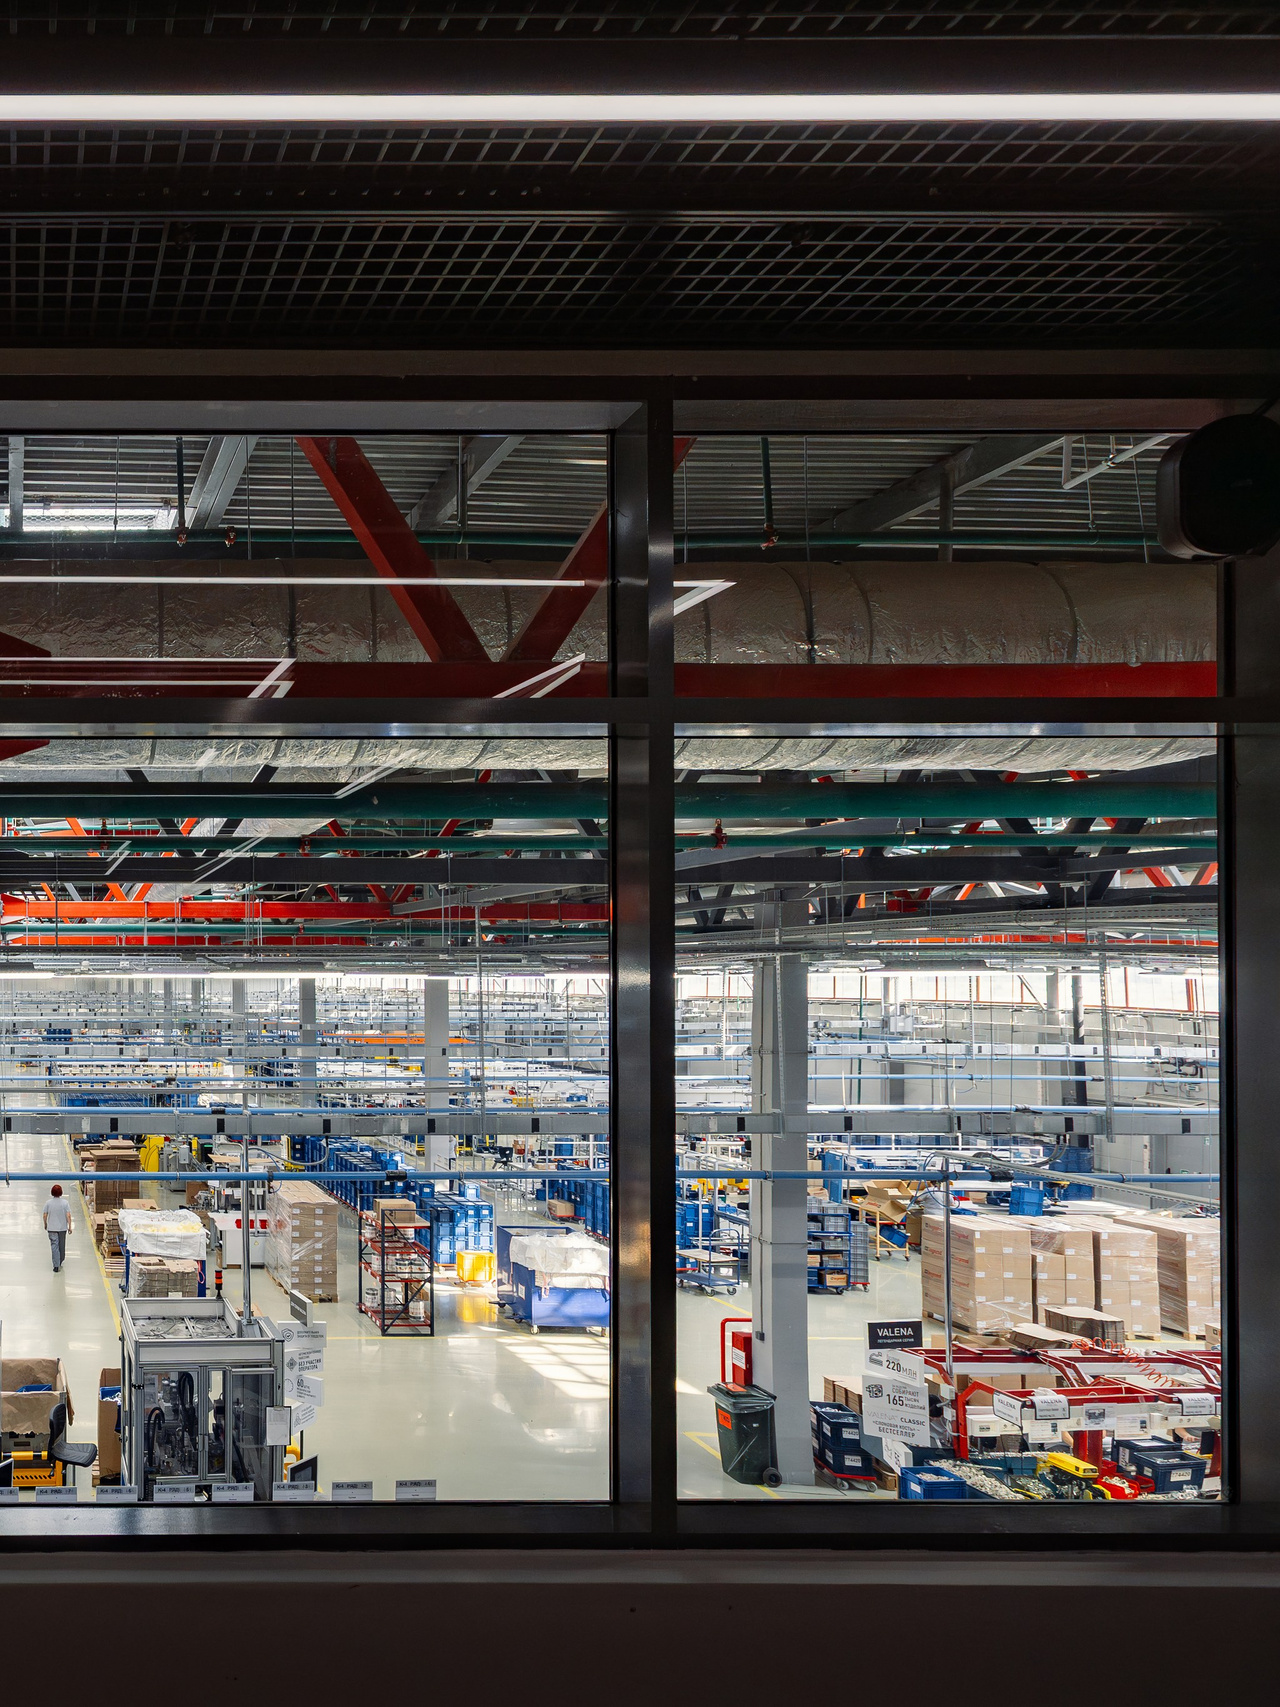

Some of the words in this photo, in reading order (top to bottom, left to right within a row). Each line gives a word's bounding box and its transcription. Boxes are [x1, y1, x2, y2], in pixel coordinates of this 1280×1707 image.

[877, 1327, 914, 1337] VALENA
[886, 1359, 902, 1373] 220
[902, 1366, 917, 1378] МЛН
[892, 1387, 919, 1398] СОБИРАЮТ
[886, 1393, 904, 1407] 165
[900, 1416, 926, 1427] CLASSIC
[878, 1426, 916, 1439] БЕСТСЕЛЛЕР
